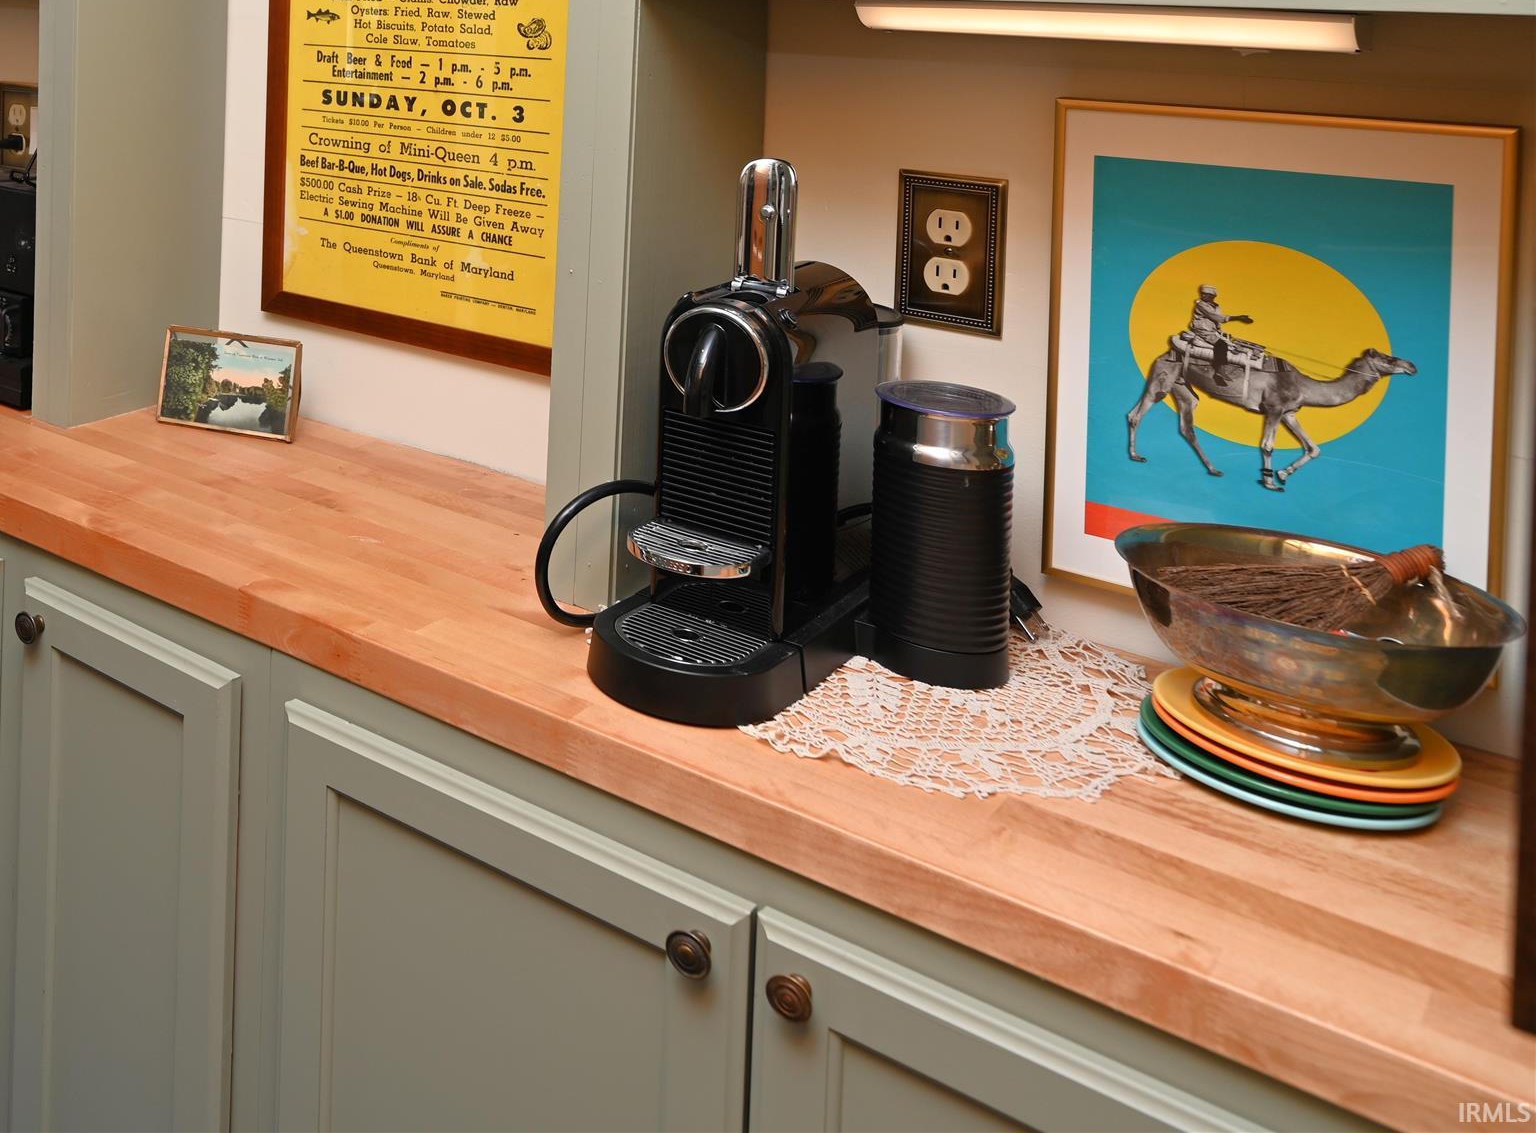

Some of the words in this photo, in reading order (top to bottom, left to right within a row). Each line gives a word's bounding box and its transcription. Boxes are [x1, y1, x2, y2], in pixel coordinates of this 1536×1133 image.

[354, 19, 371, 30] Hot
[421, 22, 455, 34] Potato
[459, 23, 493, 36] Salad,
[457, 9, 496, 21] Stewed
[366, 33, 388, 44] Cole
[426, 36, 476, 49] Tomatoes
[316, 51, 339, 64] Draft
[347, 52, 367, 66] Beer
[375, 54, 382, 67] &
[391, 55, 412, 69] Food
[438, 58, 443, 71] 1
[451, 61, 472, 74] p.m.
[494, 62, 501, 75] 5
[510, 64, 531, 78] p.m.
[332, 64, 393, 82] Entertainment
[419, 71, 426, 84] 2
[434, 73, 454, 87] p.m.
[476, 76, 483, 89] 6
[492, 78, 513, 92] p.m.
[321, 88, 427, 117] SUNDAY,
[442, 98, 497, 121] OCT.
[512, 105, 525, 123] 3
[322, 116, 345, 125] Tickets
[373, 121, 385, 129] Per
[389, 122, 412, 131] Person
[426, 126, 456, 137] Children
[461, 130, 482, 139] under
[488, 132, 496, 140] 12
[308, 132, 371, 154] Crowning
[379, 140, 391, 154] of
[400, 142, 480, 165] Mini-Queen
[489, 152, 498, 166] 4
[507, 157, 536, 174] p.m.
[300, 154, 319, 168] Beef
[321, 157, 369, 178] Bar-B-Que,
[371, 162, 387, 178] Hot
[389, 165, 415, 184] Dogs,
[417, 168, 447, 187] Drinks
[450, 176, 460, 187] on
[463, 174, 486, 191] Sale.
[488, 178, 517, 195] Sodas
[519, 182, 546, 199] Free.
[300, 190, 334, 204] Electric
[338, 195, 374, 211] Sewing
[379, 201, 423, 217] Machine
[428, 208, 450, 222] Will
[455, 212, 468, 224] Be
[473, 215, 505, 230] Given
[510, 221, 544, 238] Away
[338, 182, 363, 194] Cash
[367, 184, 391, 199] Prize
[464, 198, 490, 215] Deep
[495, 201, 531, 219] Freeze
[323, 207, 329, 217] A
[334, 209, 354, 221] $1.00
[361, 213, 400, 229] DONATION
[406, 219, 425, 232] WILL
[431, 224, 461, 238] ASSURE
[468, 229, 474, 240] A
[481, 231, 513, 247] CHANCE
[320, 237, 337, 250] The
[343, 242, 404, 264] Queenstown
[410, 253, 437, 267] Bank
[443, 258, 453, 270] of
[461, 262, 514, 282] Maryland
[420, 269, 455, 282] Maryland
